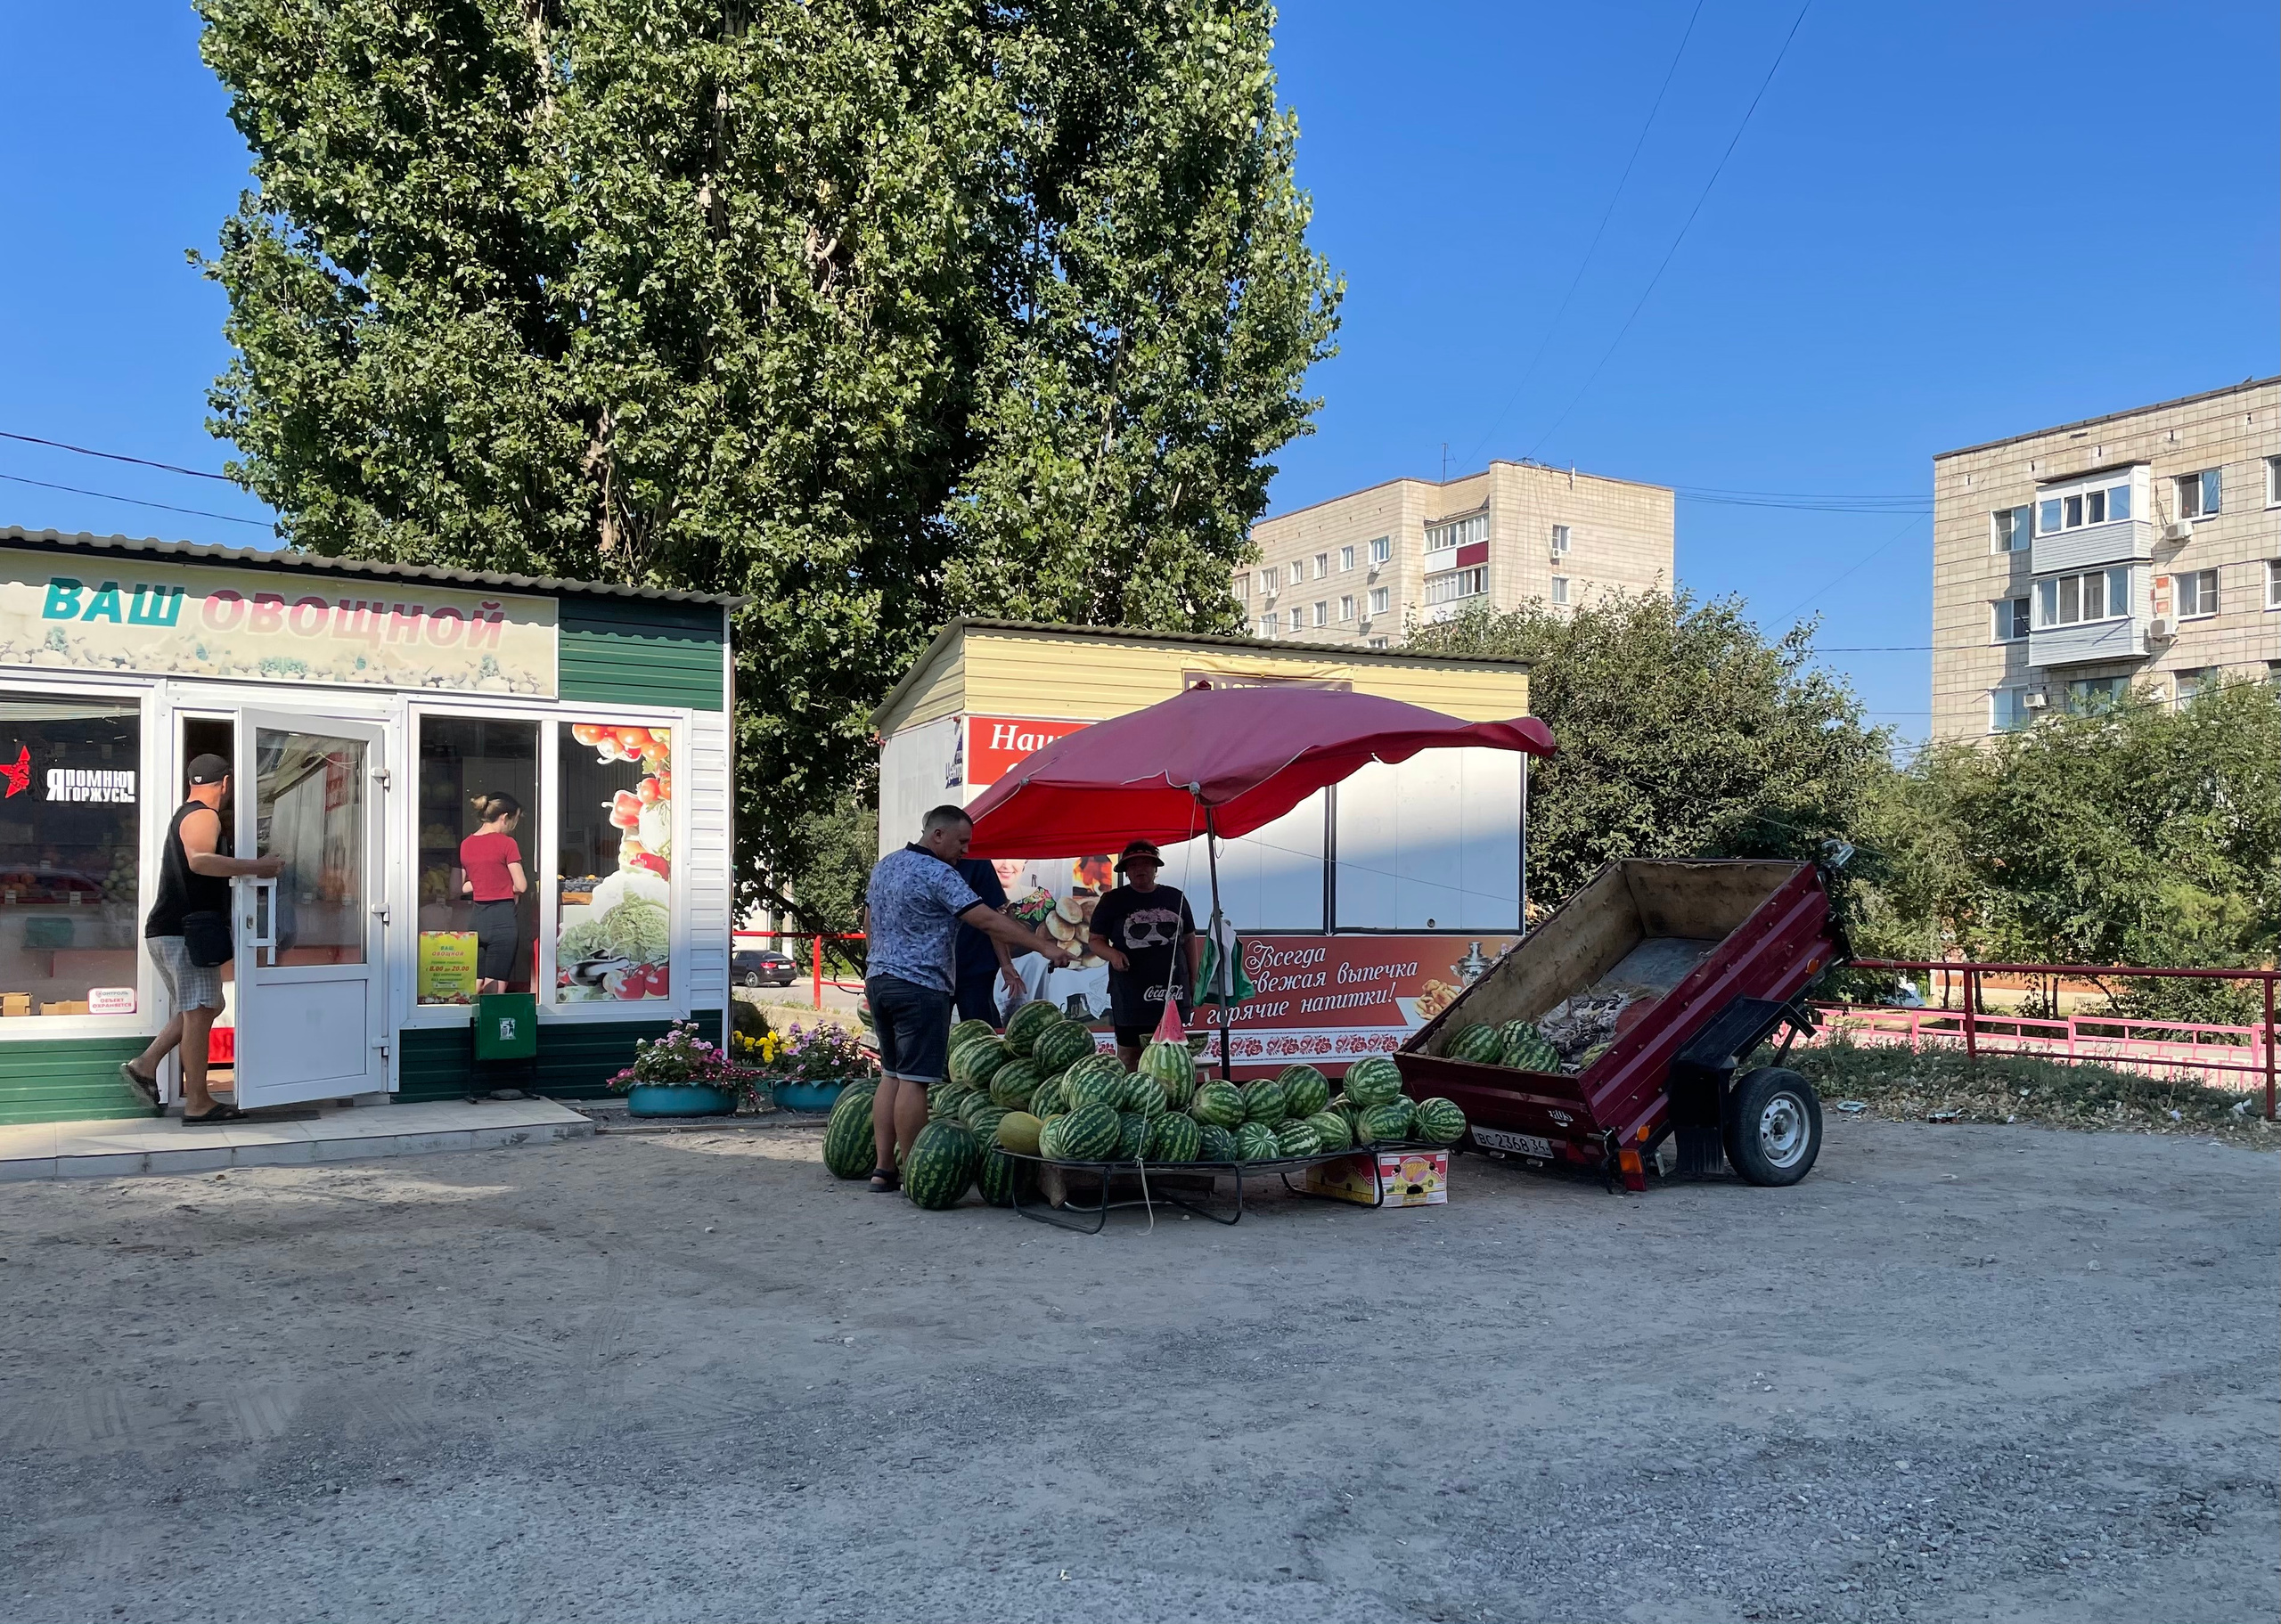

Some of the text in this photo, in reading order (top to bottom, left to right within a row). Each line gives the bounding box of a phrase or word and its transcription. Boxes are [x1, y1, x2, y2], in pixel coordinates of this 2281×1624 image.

[42, 577, 505, 651] ВАШ ОВОЩНОЙ
[46, 769, 65, 801] Я
[65, 770, 127, 788] ПОМНЮ
[65, 786, 128, 802] ГОРЖУСЬ
[1245, 940, 1326, 975] Всегда
[1337, 961, 1418, 984] выпечка
[1206, 1000, 1289, 1027] горячие
[1300, 982, 1396, 1014] напитки!
[1494, 1133, 1531, 1153] 2368
[1529, 1138, 1547, 1152] 34
